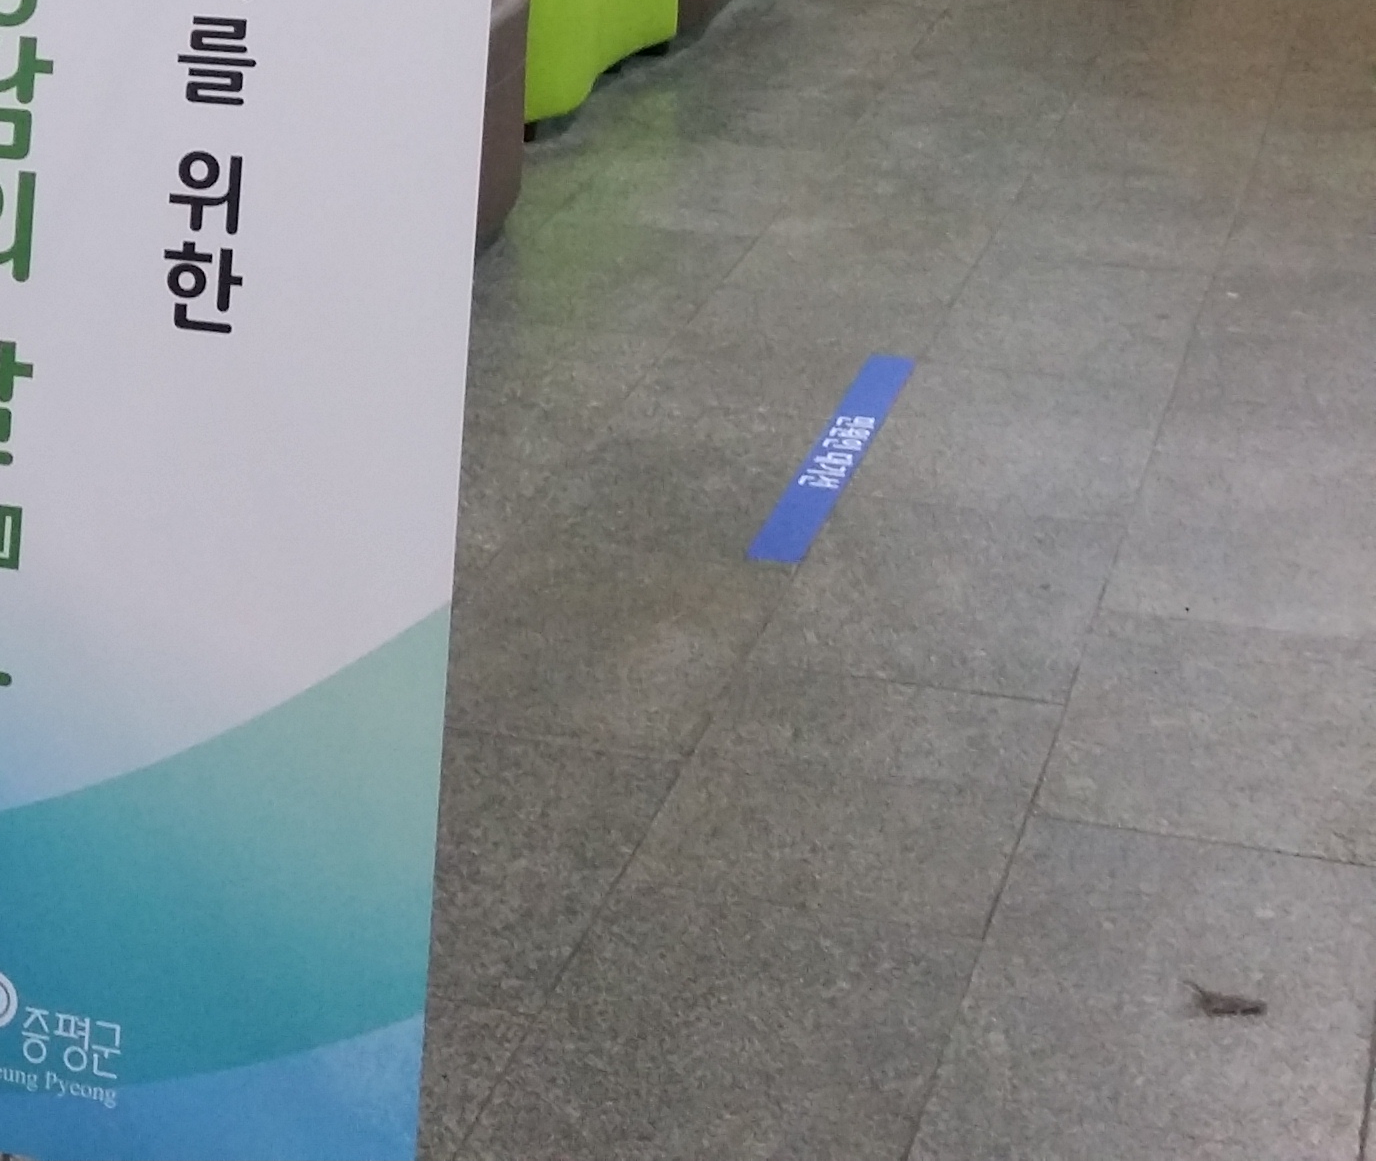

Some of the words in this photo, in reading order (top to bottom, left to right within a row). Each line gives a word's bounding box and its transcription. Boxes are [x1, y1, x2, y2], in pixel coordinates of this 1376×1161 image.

[163, 149, 244, 334] 위한
[20, 1005, 122, 1080] 증평군
[45, 1070, 118, 1110] Pyeong
